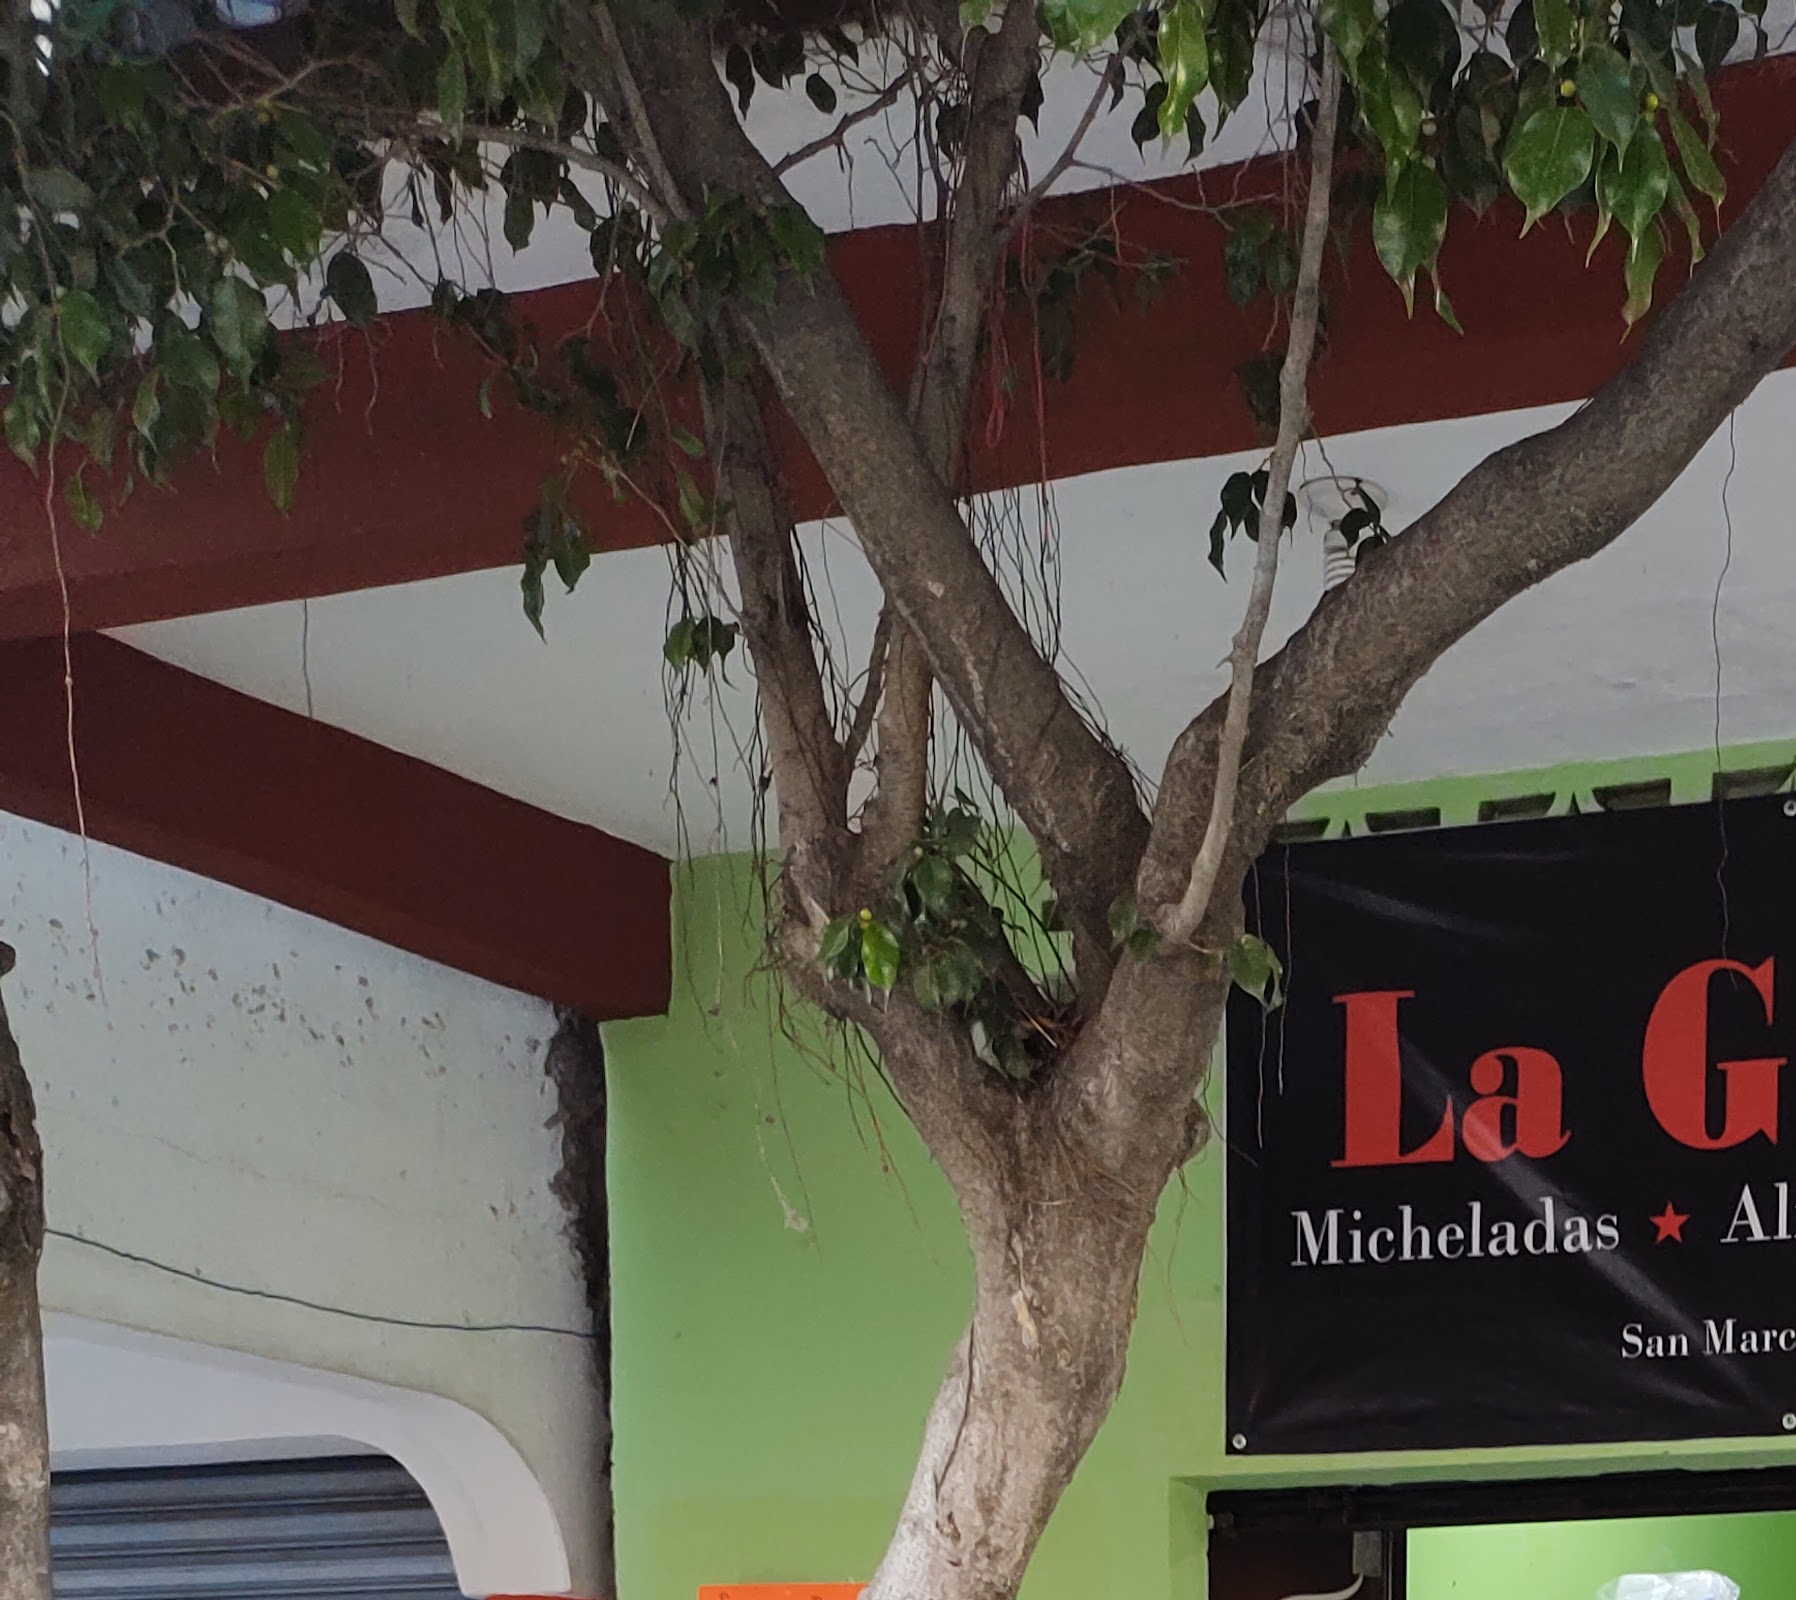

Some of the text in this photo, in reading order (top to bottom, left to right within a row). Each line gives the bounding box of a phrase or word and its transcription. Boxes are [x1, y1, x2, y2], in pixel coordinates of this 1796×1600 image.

[1330, 989, 1571, 1168] La
[1290, 1197, 1620, 1268] Micheladas
[1621, 1323, 1689, 1359] San
